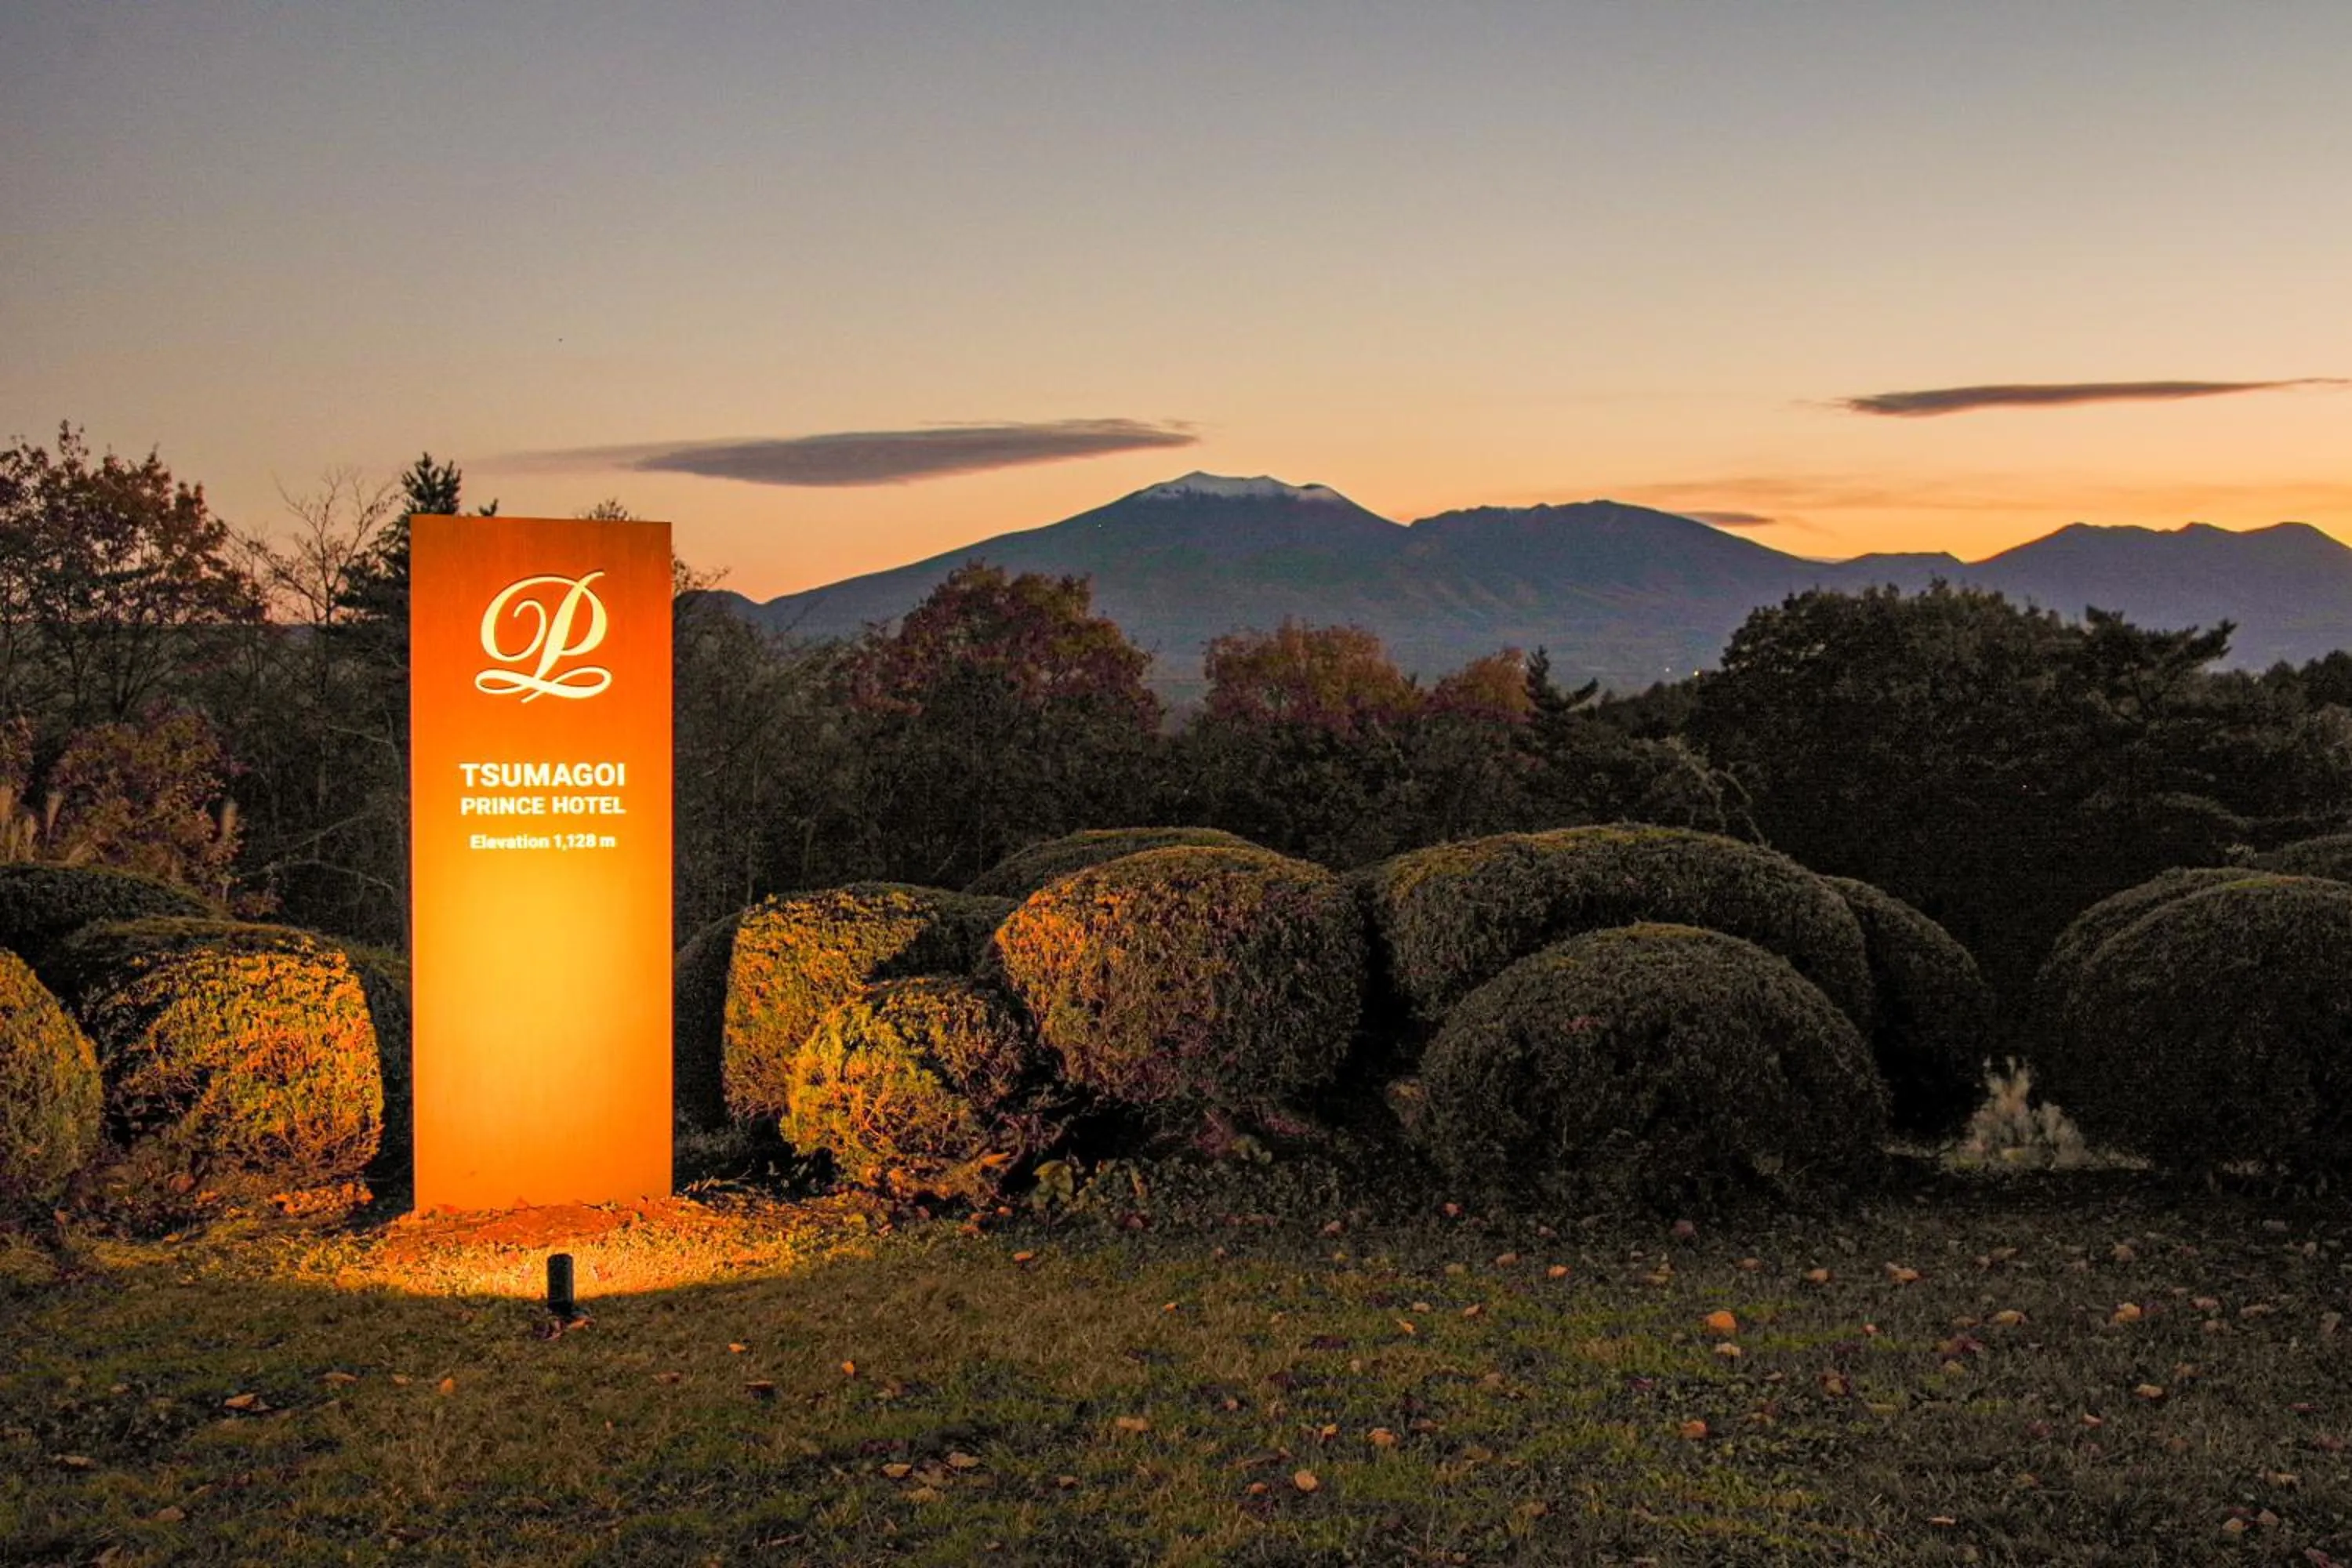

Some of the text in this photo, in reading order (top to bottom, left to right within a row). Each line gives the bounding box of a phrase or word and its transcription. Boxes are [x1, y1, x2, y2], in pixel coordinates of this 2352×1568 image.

[459, 763, 625, 787] TSUMAGOI
[460, 797, 626, 815] PRINCE HOTEL
[470, 834, 615, 851] Elevation 1,128 m
